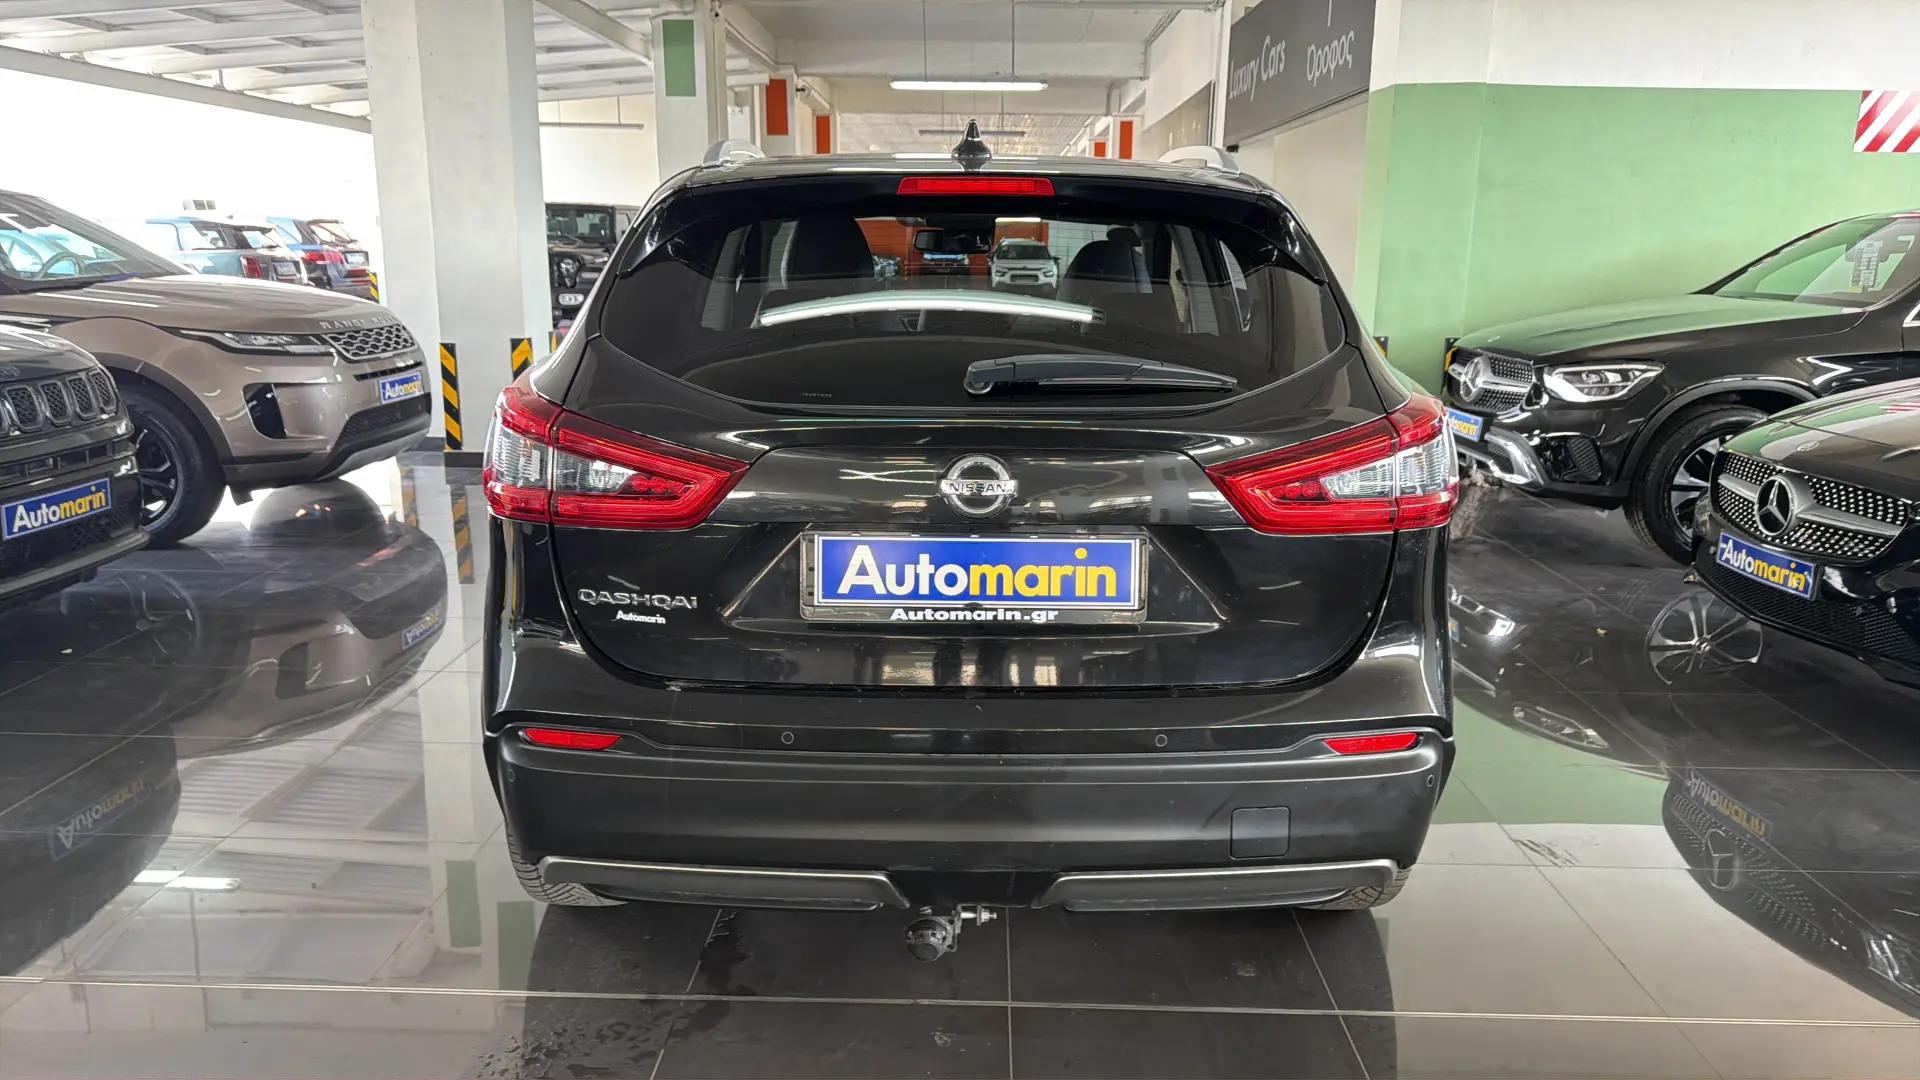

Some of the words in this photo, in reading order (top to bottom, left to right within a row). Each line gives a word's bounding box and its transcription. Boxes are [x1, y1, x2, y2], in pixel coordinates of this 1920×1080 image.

[1229, 57, 1260, 102] Luxury
[1261, 35, 1286, 82] Cars
[13, 485, 106, 533] Automarin
[950, 482, 1006, 493] NISSAN
[837, 544, 1117, 597] Automarin
[1721, 539, 1807, 592] Automarin
[616, 609, 666, 624] Automarin
[890, 608, 1059, 623] Automarin.gr
